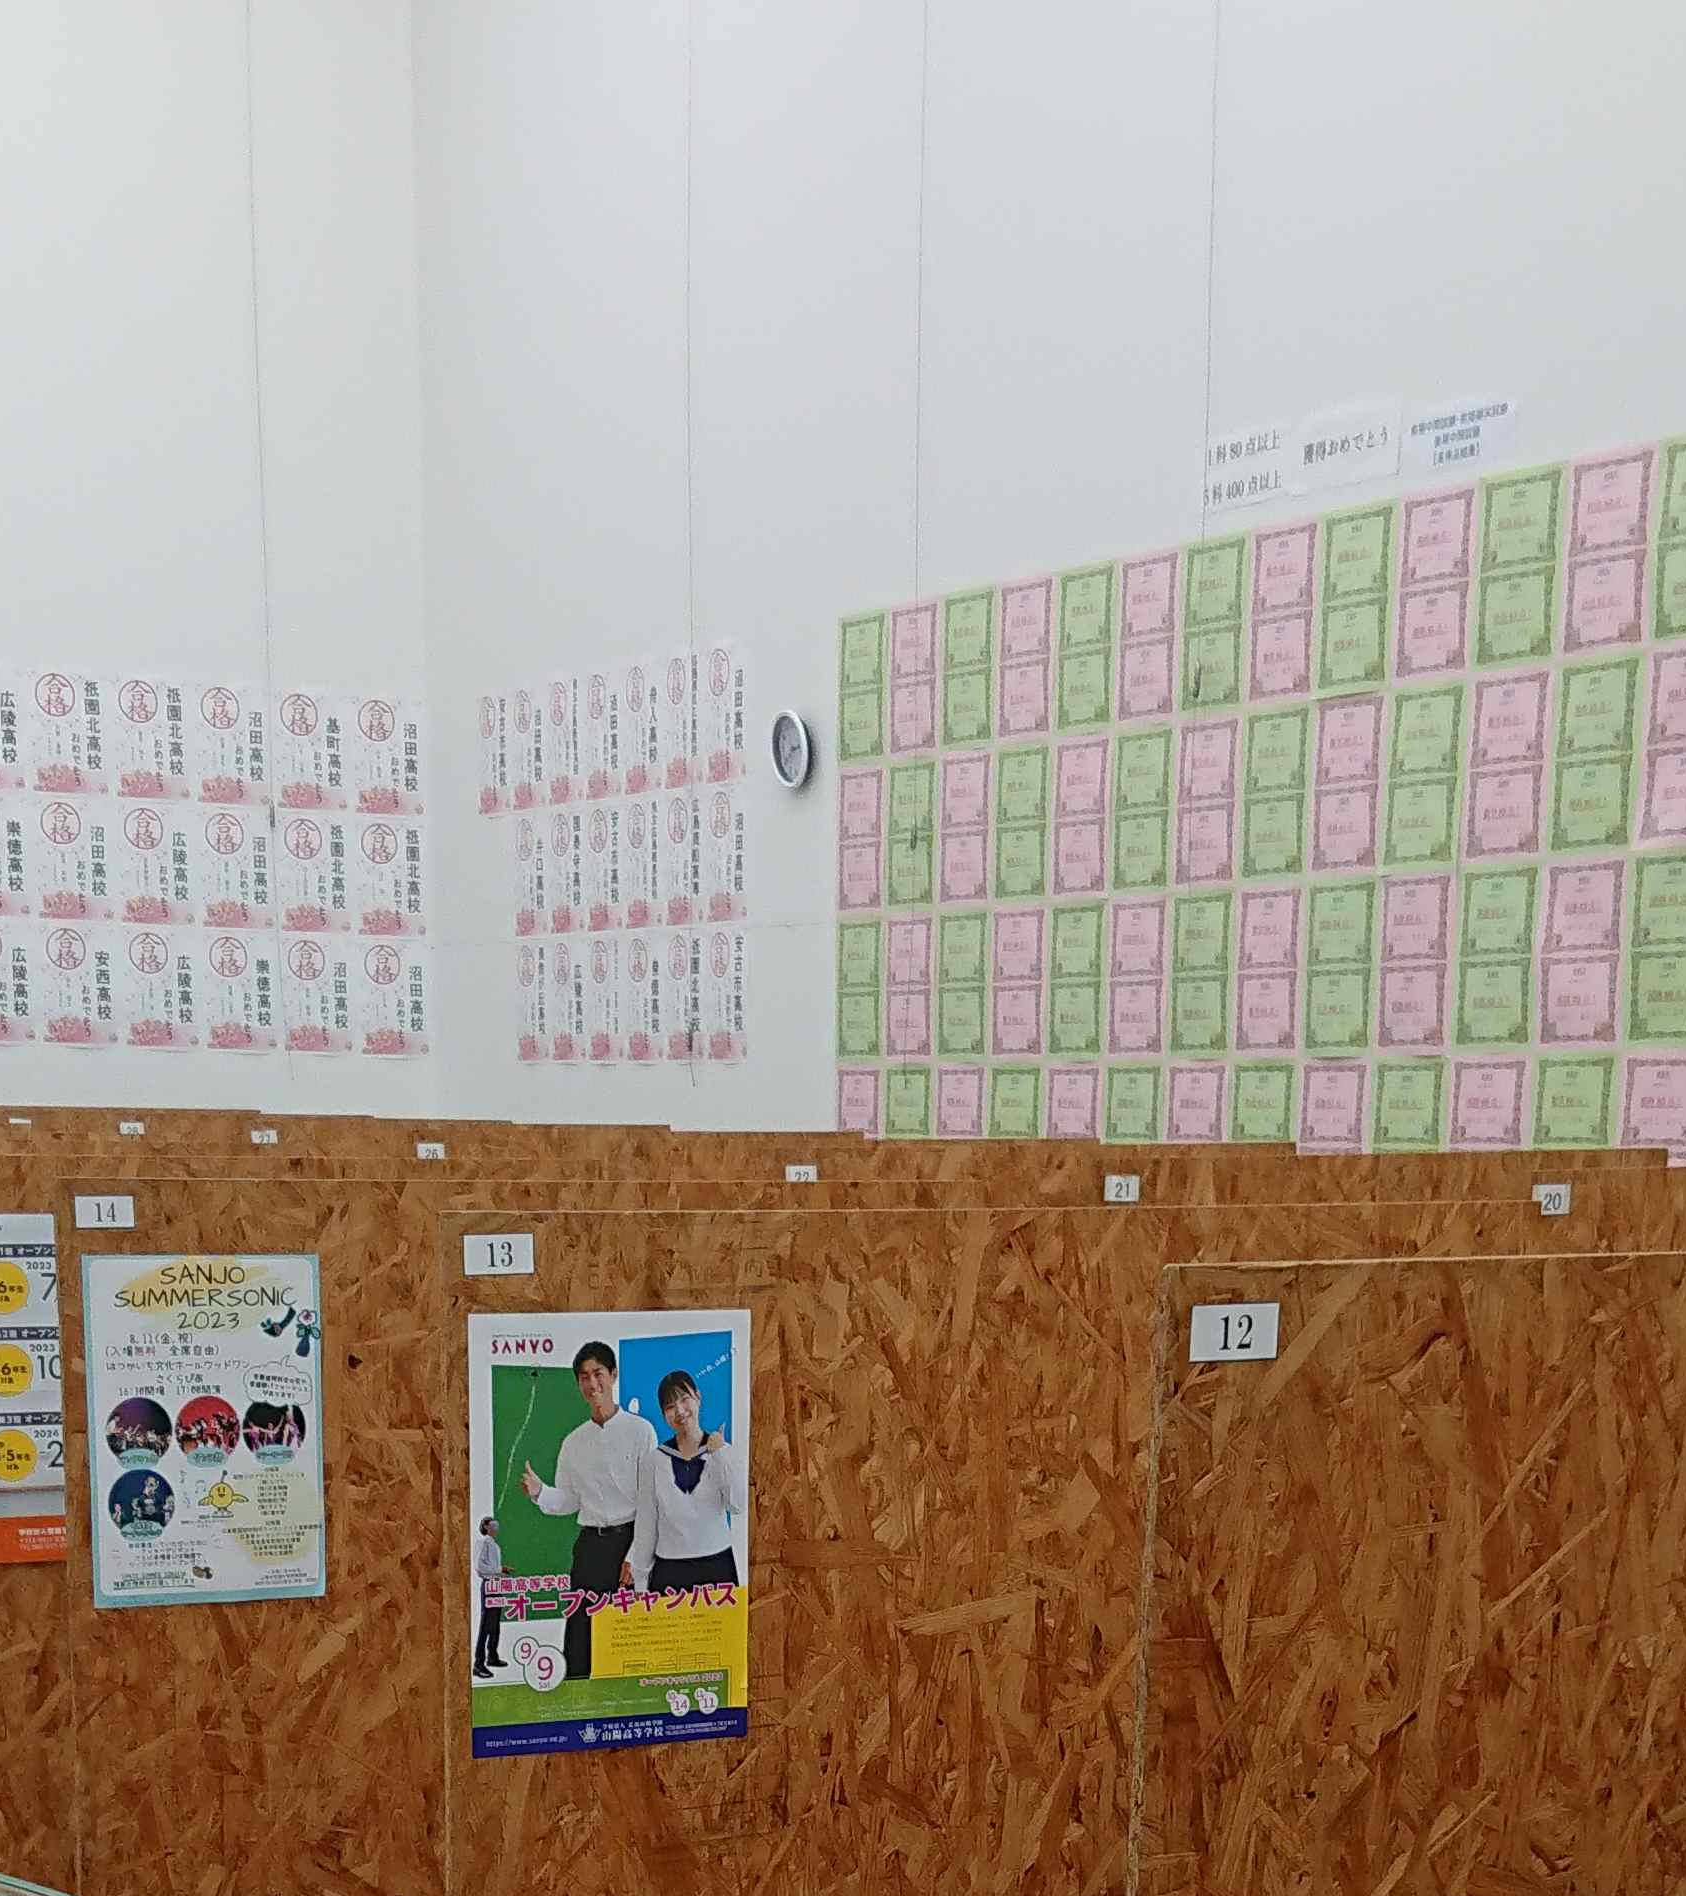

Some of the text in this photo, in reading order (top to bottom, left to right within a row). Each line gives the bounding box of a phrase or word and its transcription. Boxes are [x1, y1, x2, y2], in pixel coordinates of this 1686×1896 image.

[1114, 1182, 1130, 1199] 21
[1543, 1192, 1562, 1212] 20
[94, 1202, 116, 1223] 14
[486, 1241, 514, 1269] 13
[26, 1261, 52, 1270] 2023
[159, 1263, 246, 1285] SANJO
[114, 1286, 298, 1309] SUMMERSONIC
[177, 1311, 242, 1330] 2023
[1219, 1314, 1254, 1351] 12
[29, 1343, 56, 1352] 2023
[491, 1338, 555, 1354] SANYO
[485, 1576, 571, 1593] 山陽高等学校
[505, 1583, 739, 1622] オープンキャンパス
